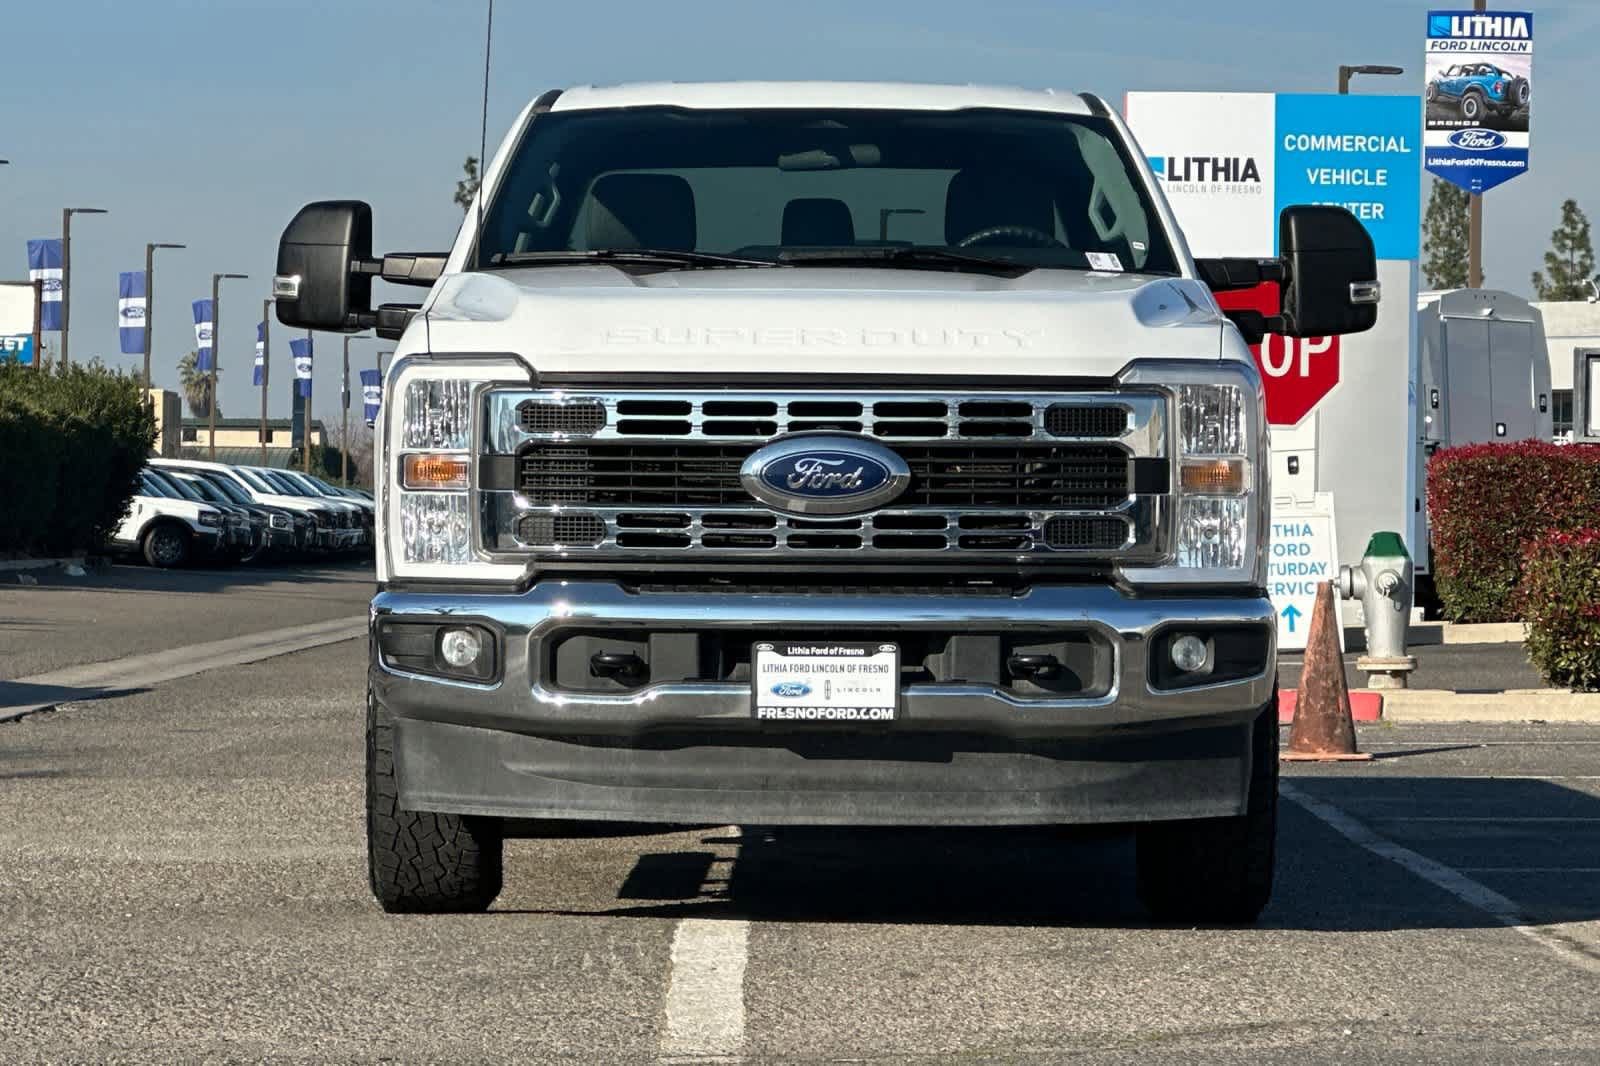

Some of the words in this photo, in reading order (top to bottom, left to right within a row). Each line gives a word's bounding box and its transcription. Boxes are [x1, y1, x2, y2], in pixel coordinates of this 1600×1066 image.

[1451, 16, 1529, 37] LITHIA
[1431, 40, 1467, 50] FORD
[1470, 41, 1528, 51] LINCOLN
[1284, 134, 1411, 153] COMMERCIAL
[1459, 131, 1496, 147] Ford
[1167, 157, 1261, 182] LITHIA
[1306, 168, 1388, 186] VEHICLE
[1167, 184, 1207, 193] LINCOLN
[1211, 184, 1223, 193] OF
[1225, 184, 1262, 194] FRESNO
[1311, 201, 1384, 219] TER
[1261, 333, 1332, 377] OP
[786, 457, 864, 489] Ford
[1272, 523, 1313, 537] THIA
[1273, 543, 1311, 556] ORD
[1269, 562, 1327, 576] TURDAY
[787, 646, 810, 655] Lithia
[811, 646, 829, 655] Ford
[829, 646, 838, 655] of
[839, 647, 865, 655] Fresno
[762, 664, 788, 672] LITHIA
[789, 664, 810, 672] FORD
[812, 664, 845, 673] LINCOLN
[847, 664, 857, 673] OF
[858, 664, 889, 673] FRESNO
[778, 684, 803, 697] Ford
[757, 708, 894, 720] FRESNOFORD.COM
